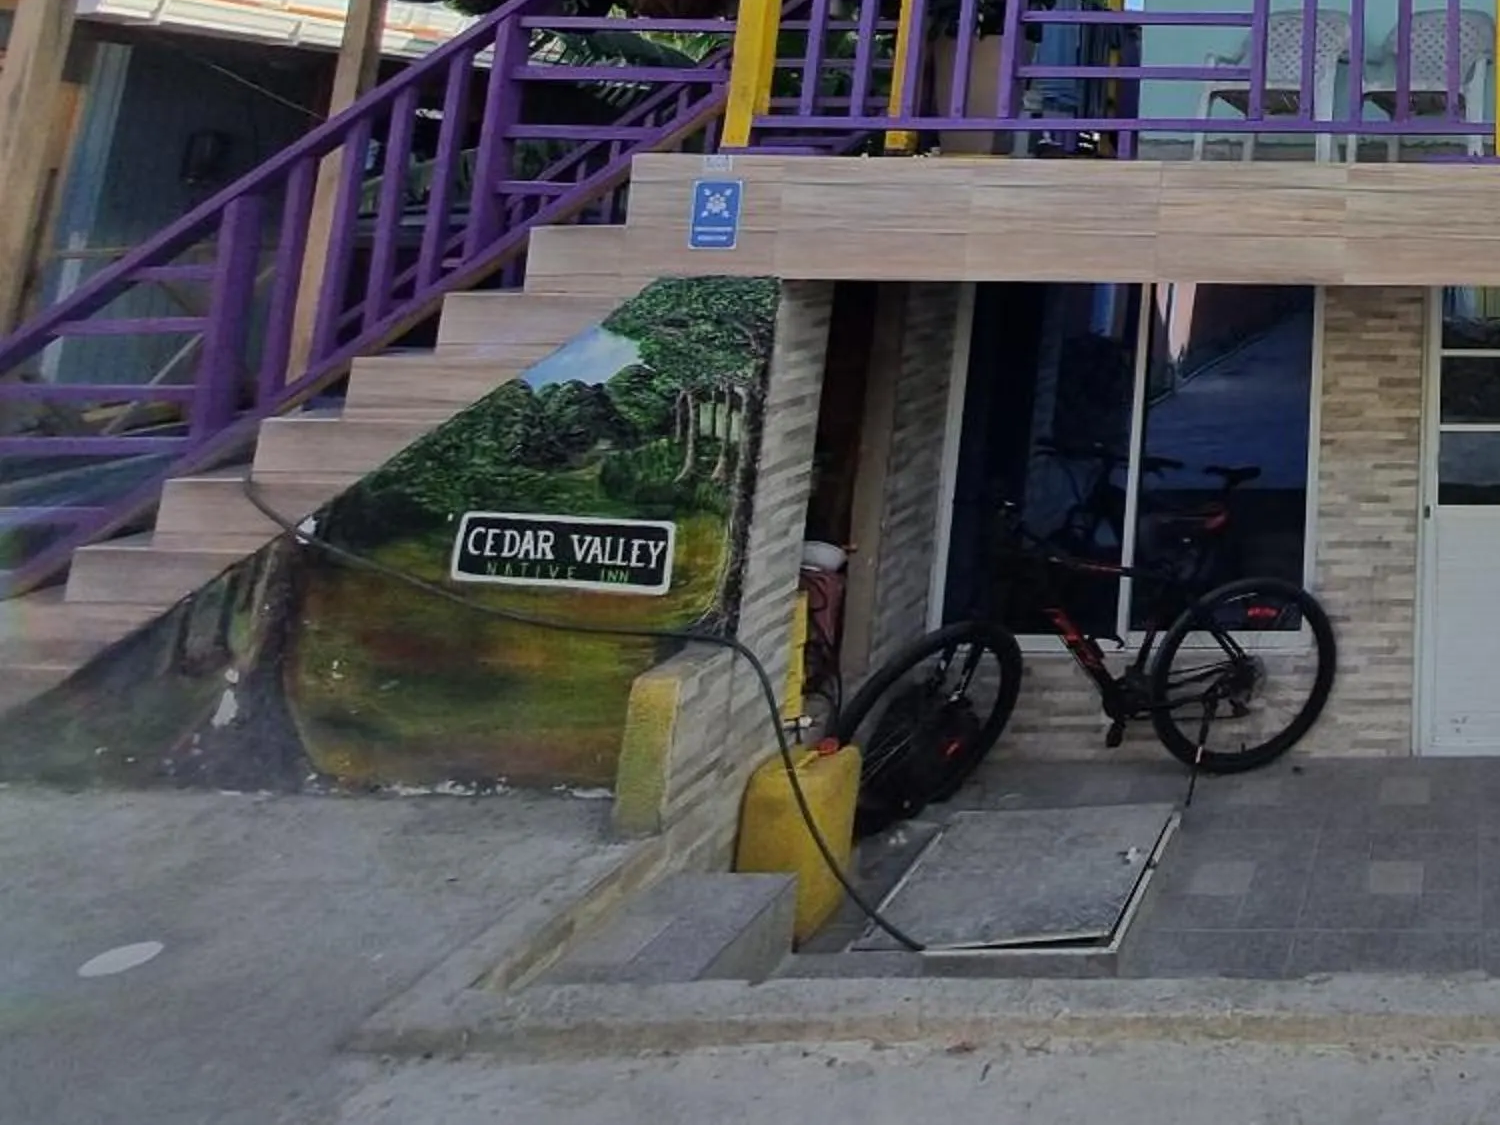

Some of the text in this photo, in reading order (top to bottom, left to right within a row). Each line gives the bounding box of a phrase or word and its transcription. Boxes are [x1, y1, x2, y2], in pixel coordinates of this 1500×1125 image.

[468, 527, 666, 569] CEDAR VALLEY
[487, 562, 630, 583] NATIVE INN
